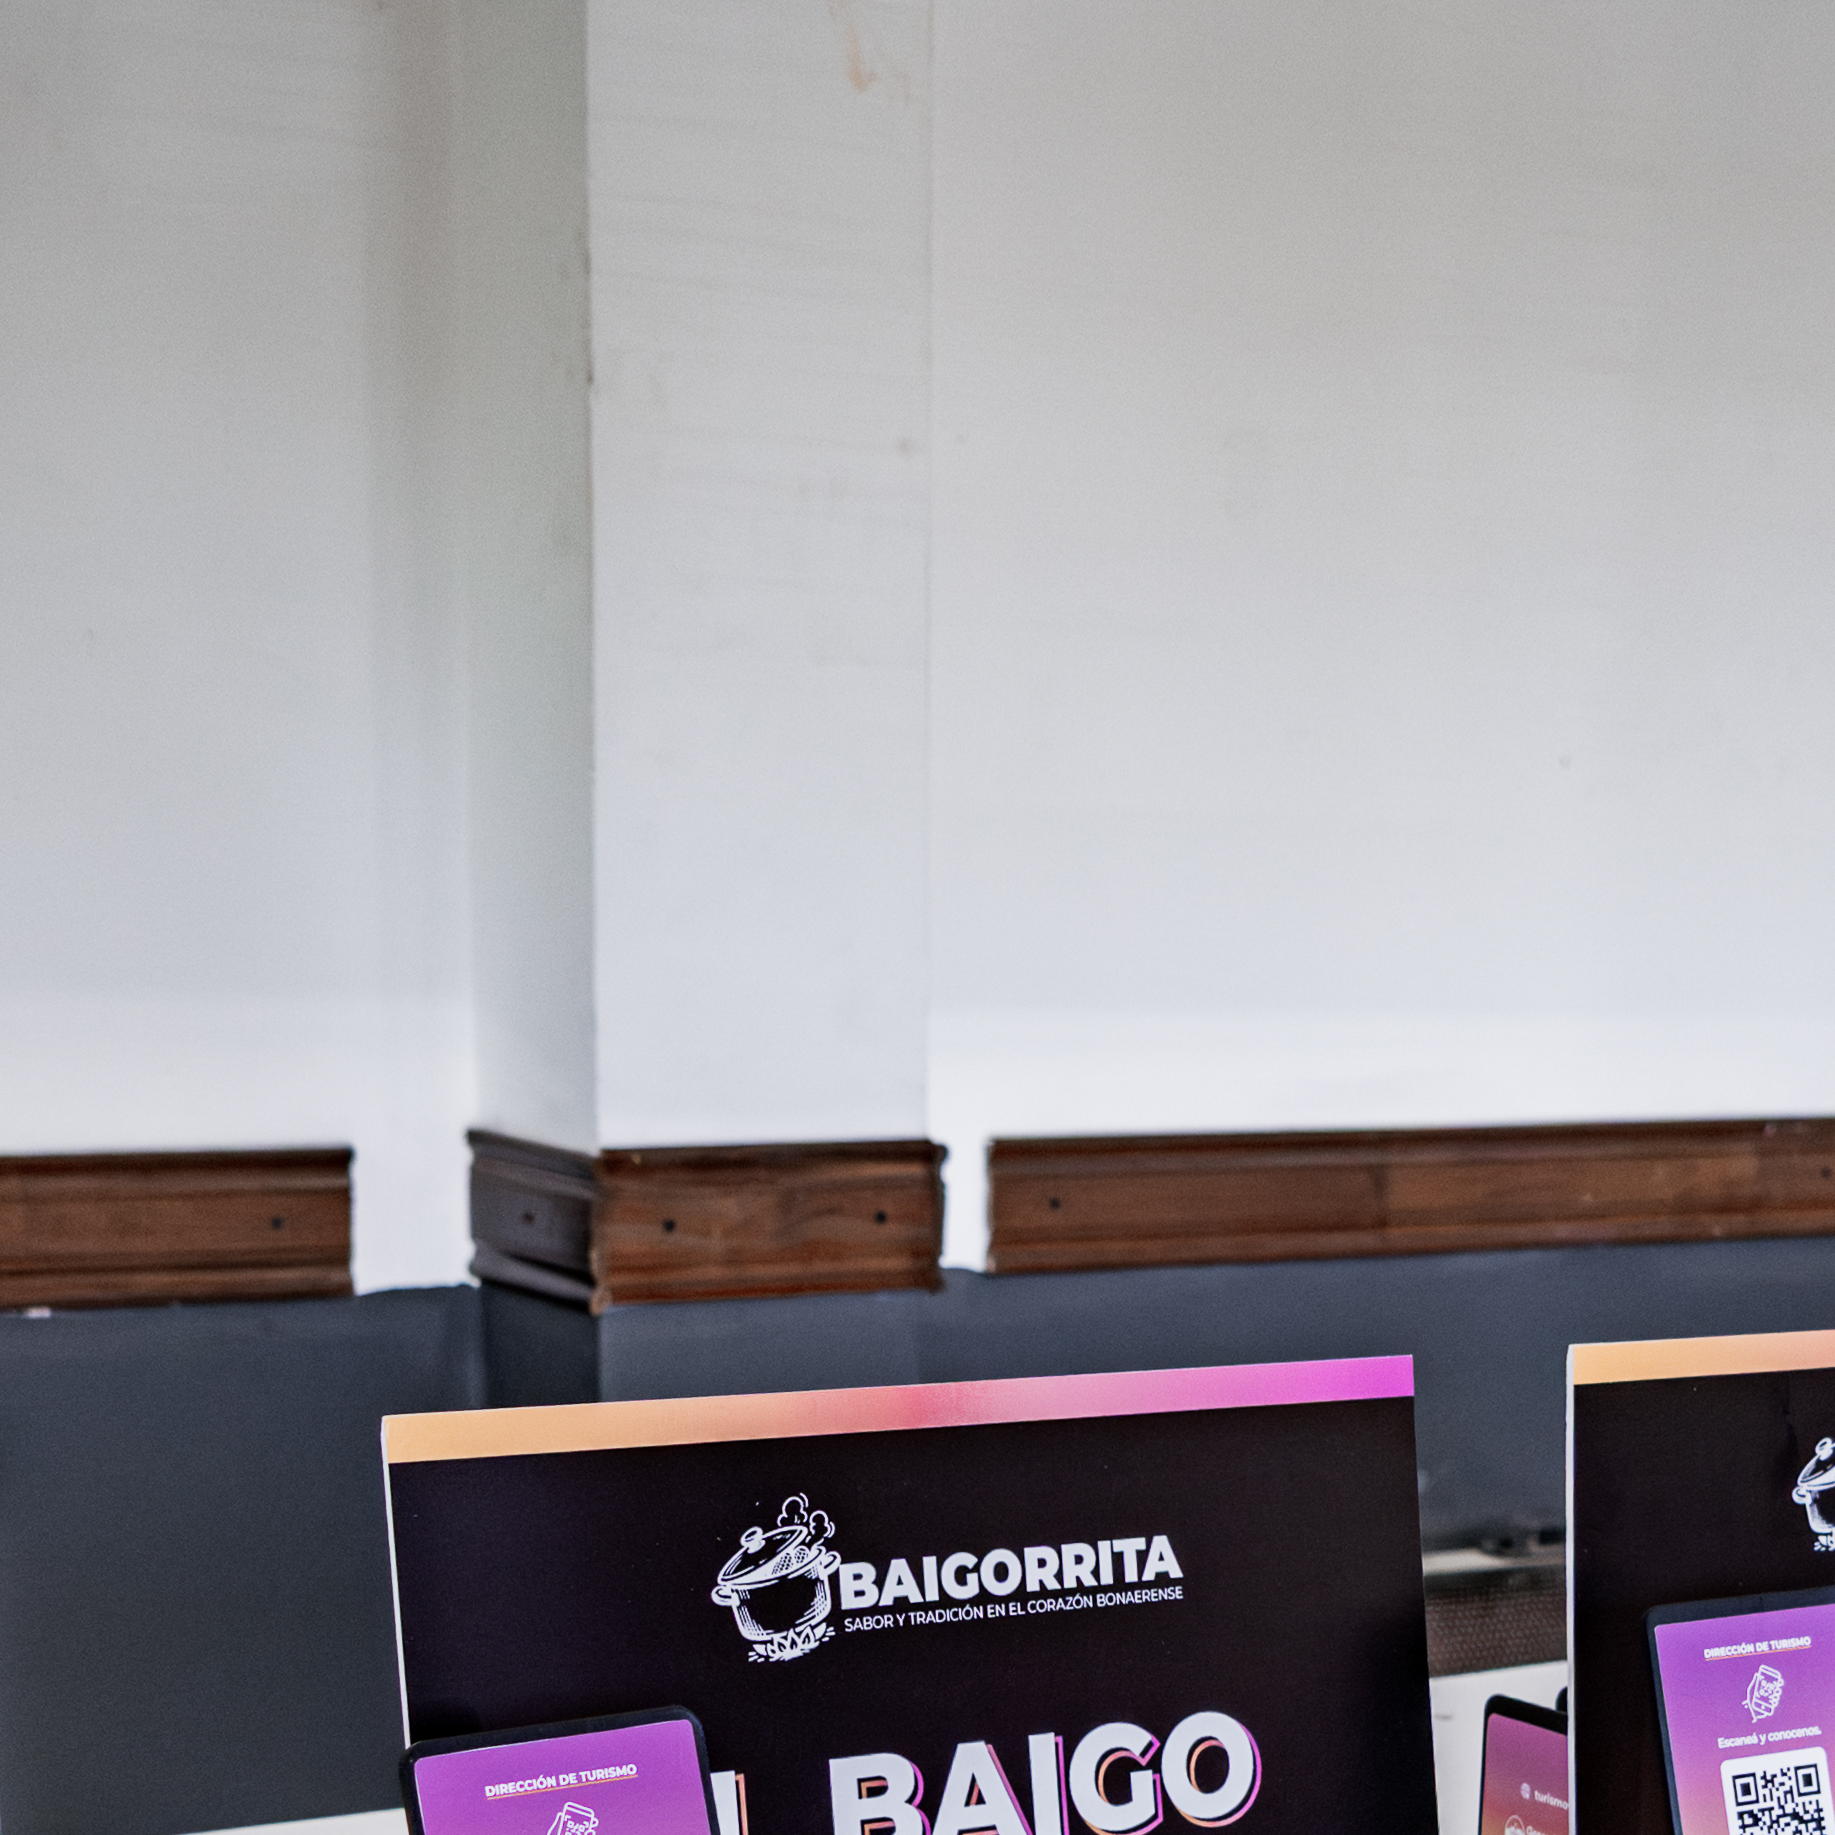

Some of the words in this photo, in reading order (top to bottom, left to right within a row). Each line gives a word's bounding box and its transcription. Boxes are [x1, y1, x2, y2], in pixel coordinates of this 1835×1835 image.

[839, 1534, 1184, 1610] BAIGORRITA
[844, 1615, 894, 1632] SABOR
[896, 1614, 906, 1627] Y
[908, 1604, 983, 1626] TRADICIÓN
[987, 1604, 1006, 1618] EN
[1009, 1602, 1025, 1616] EL
[1027, 1593, 1093, 1614] CORAZÓN
[1096, 1586, 1184, 1607] BONAERENSE
[1755, 1641, 1769, 1652] DE
[1769, 1636, 1811, 1650] TURISMO
[1759, 1733, 1766, 1746] y
[485, 1775, 557, 1797] DIRECCIÓN
[559, 1773, 578, 1786] DE
[579, 1764, 638, 1782] TURISMO
[1534, 1789, 1569, 1811] turismo
